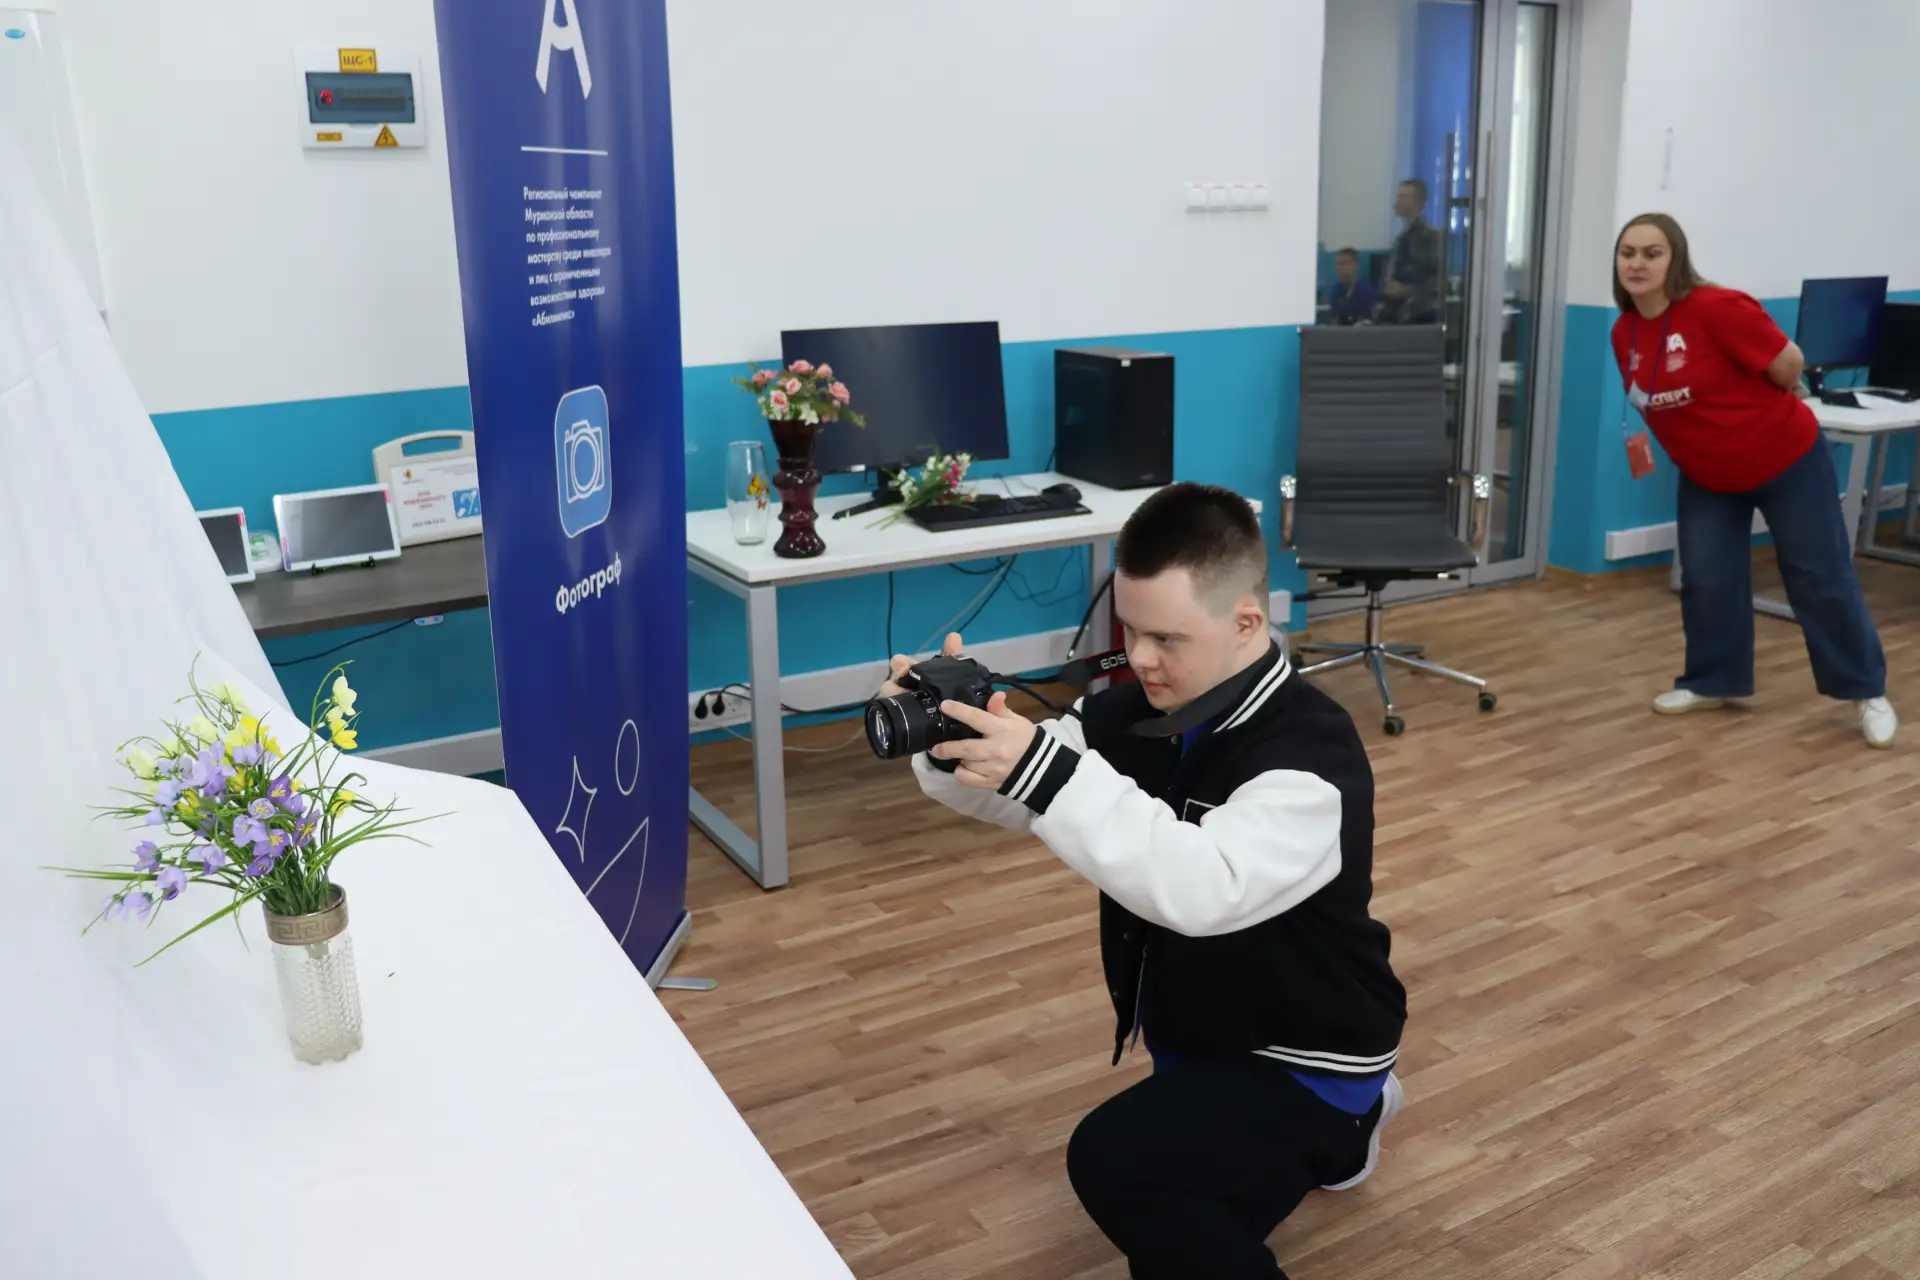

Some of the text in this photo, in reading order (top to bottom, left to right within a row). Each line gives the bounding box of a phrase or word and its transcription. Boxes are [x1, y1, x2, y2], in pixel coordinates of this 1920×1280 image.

[343, 55, 373, 66] ЩС-1
[566, 205, 594, 220] области
[526, 232, 536, 243] по
[529, 276, 535, 285] и
[535, 274, 549, 285] лиц
[555, 551, 622, 616] Фотограф
[1099, 653, 1127, 670] EOS
